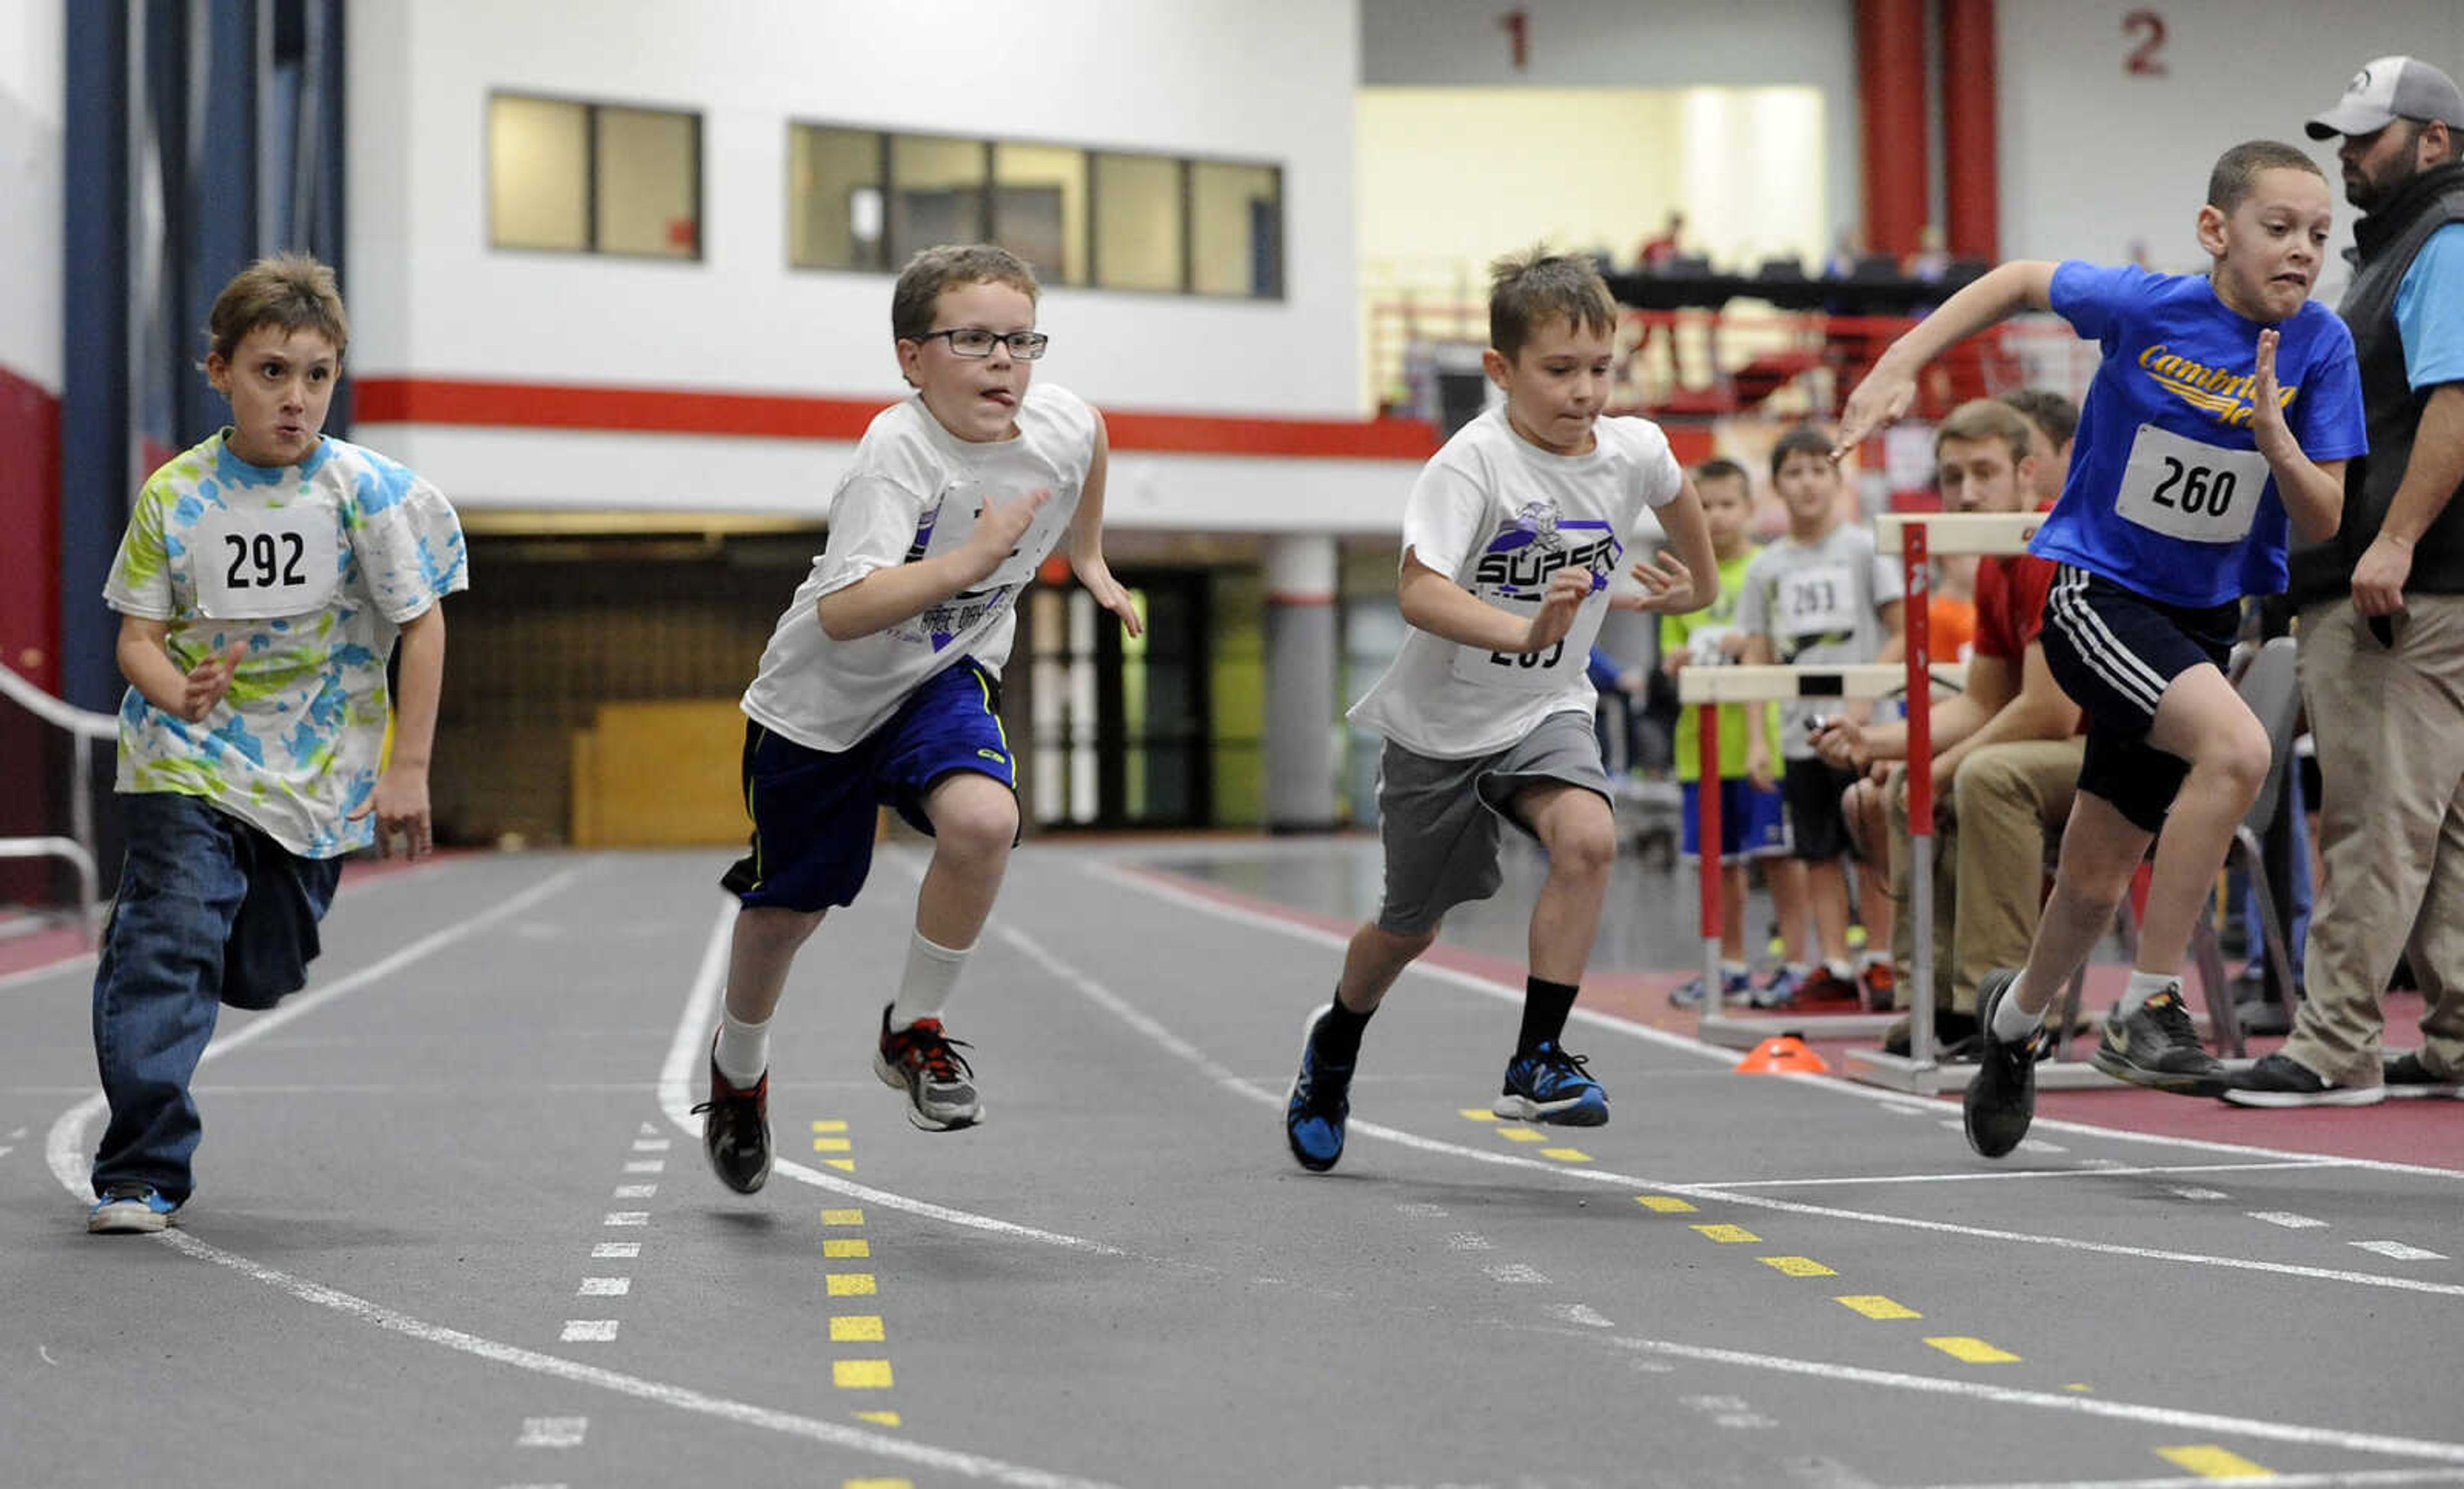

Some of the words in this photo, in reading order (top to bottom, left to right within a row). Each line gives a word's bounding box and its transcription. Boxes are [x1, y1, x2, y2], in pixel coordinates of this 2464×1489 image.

[2123, 12, 2166, 77] 2
[2152, 455, 2237, 517] 260
[225, 532, 306, 589] 292
[1475, 534, 1615, 586] SUPER
